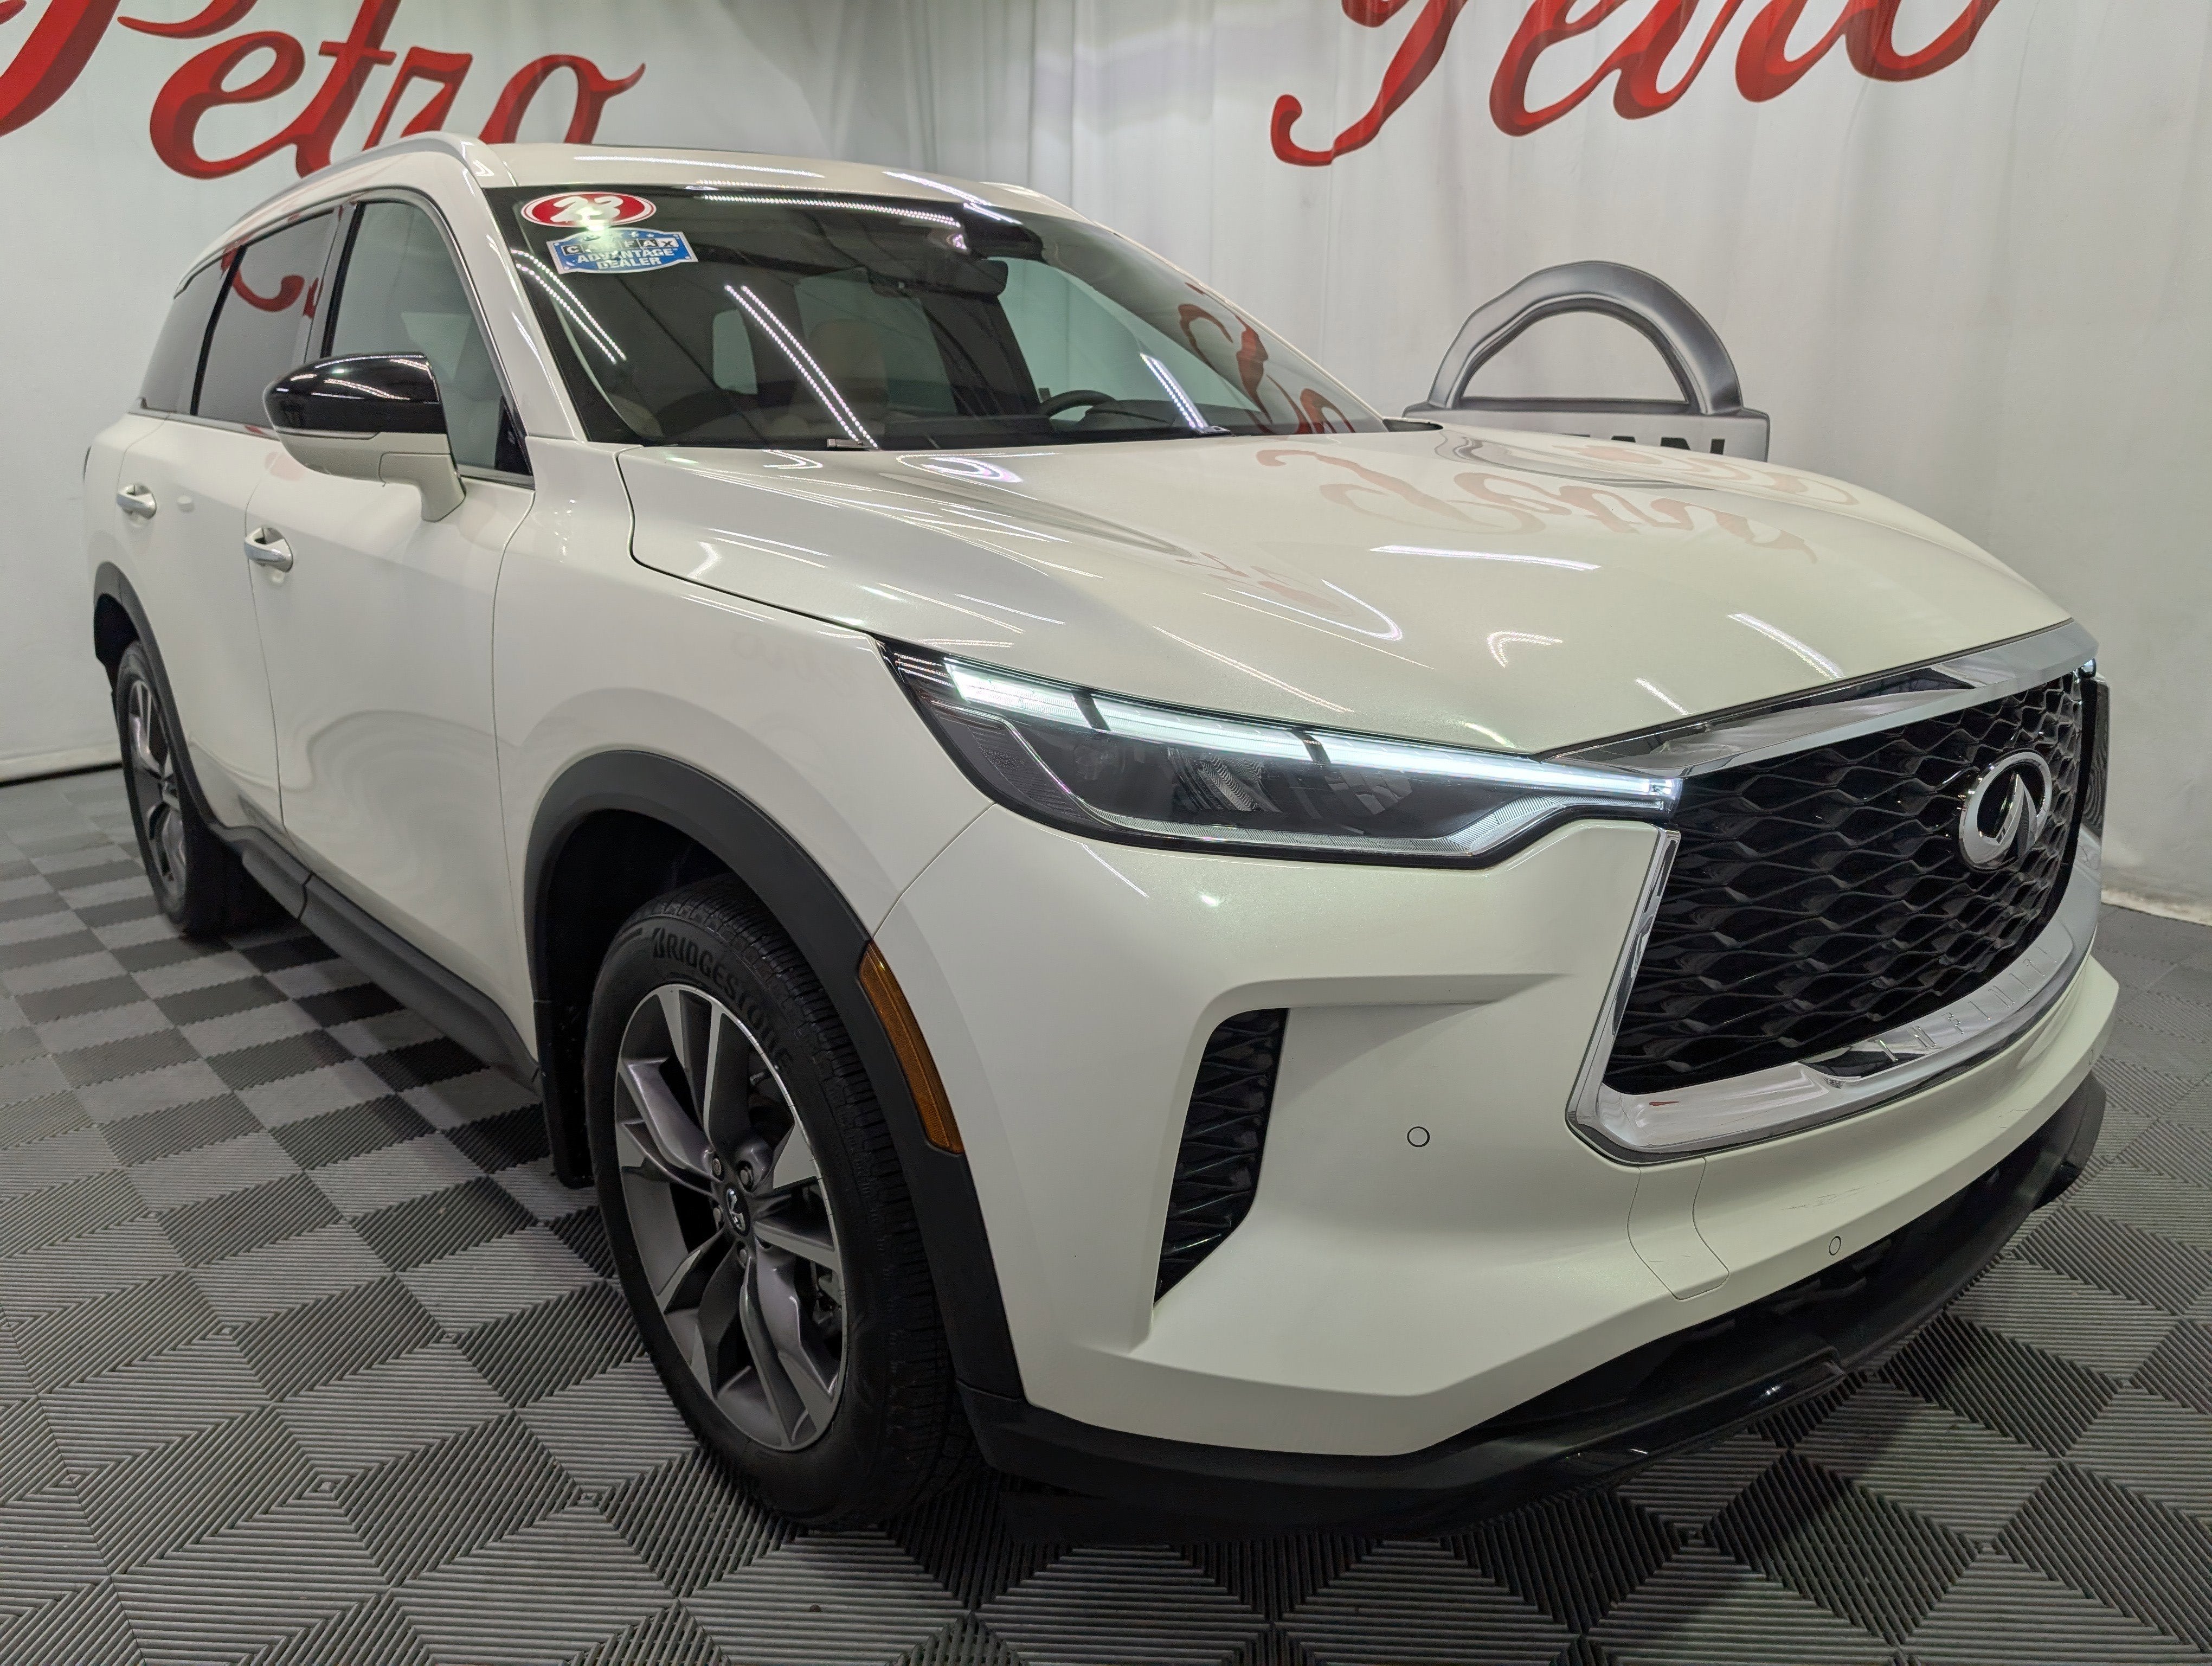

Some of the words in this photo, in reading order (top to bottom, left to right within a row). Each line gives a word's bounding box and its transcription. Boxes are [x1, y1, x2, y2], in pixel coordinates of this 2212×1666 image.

[565, 238, 674, 254] CARFAX
[577, 248, 674, 264] ADVANTAGE
[596, 257, 662, 270] DEALER
[651, 927, 794, 1070] BRIDGESTONE
[1875, 946, 2059, 1063] INFINITI
